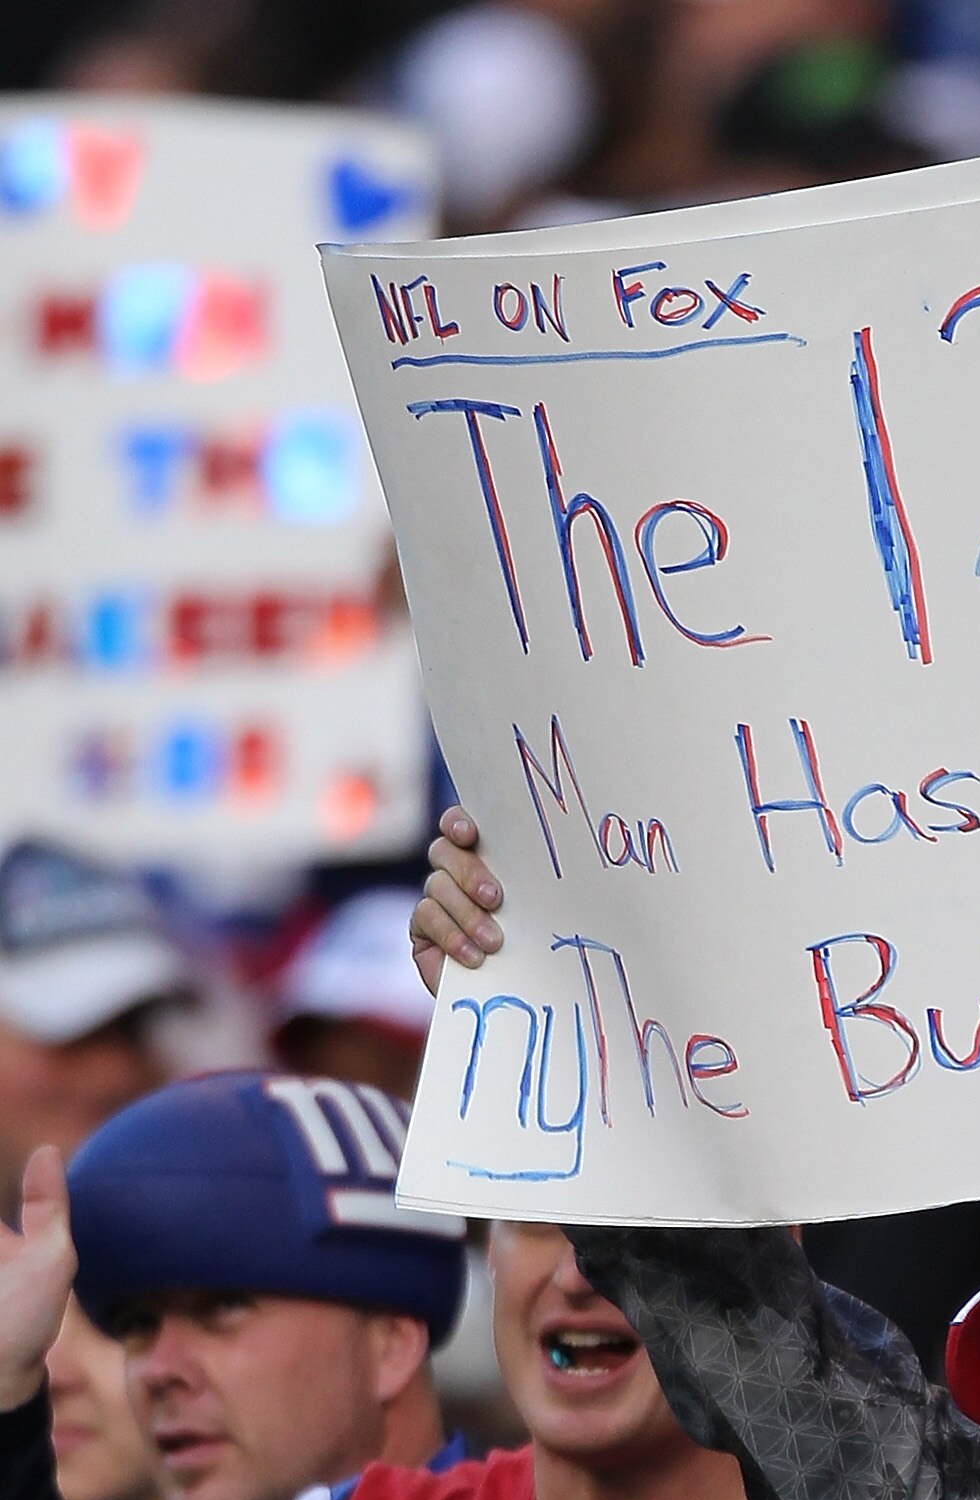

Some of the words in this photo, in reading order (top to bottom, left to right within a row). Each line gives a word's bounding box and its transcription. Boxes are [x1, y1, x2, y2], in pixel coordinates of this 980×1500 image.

[370, 274, 461, 345] NFL
[492, 272, 571, 344] ON
[406, 400, 774, 669] The
[511, 713, 681, 880] Man
[445, 993, 589, 1183] ny
[551, 932, 751, 1128] The
